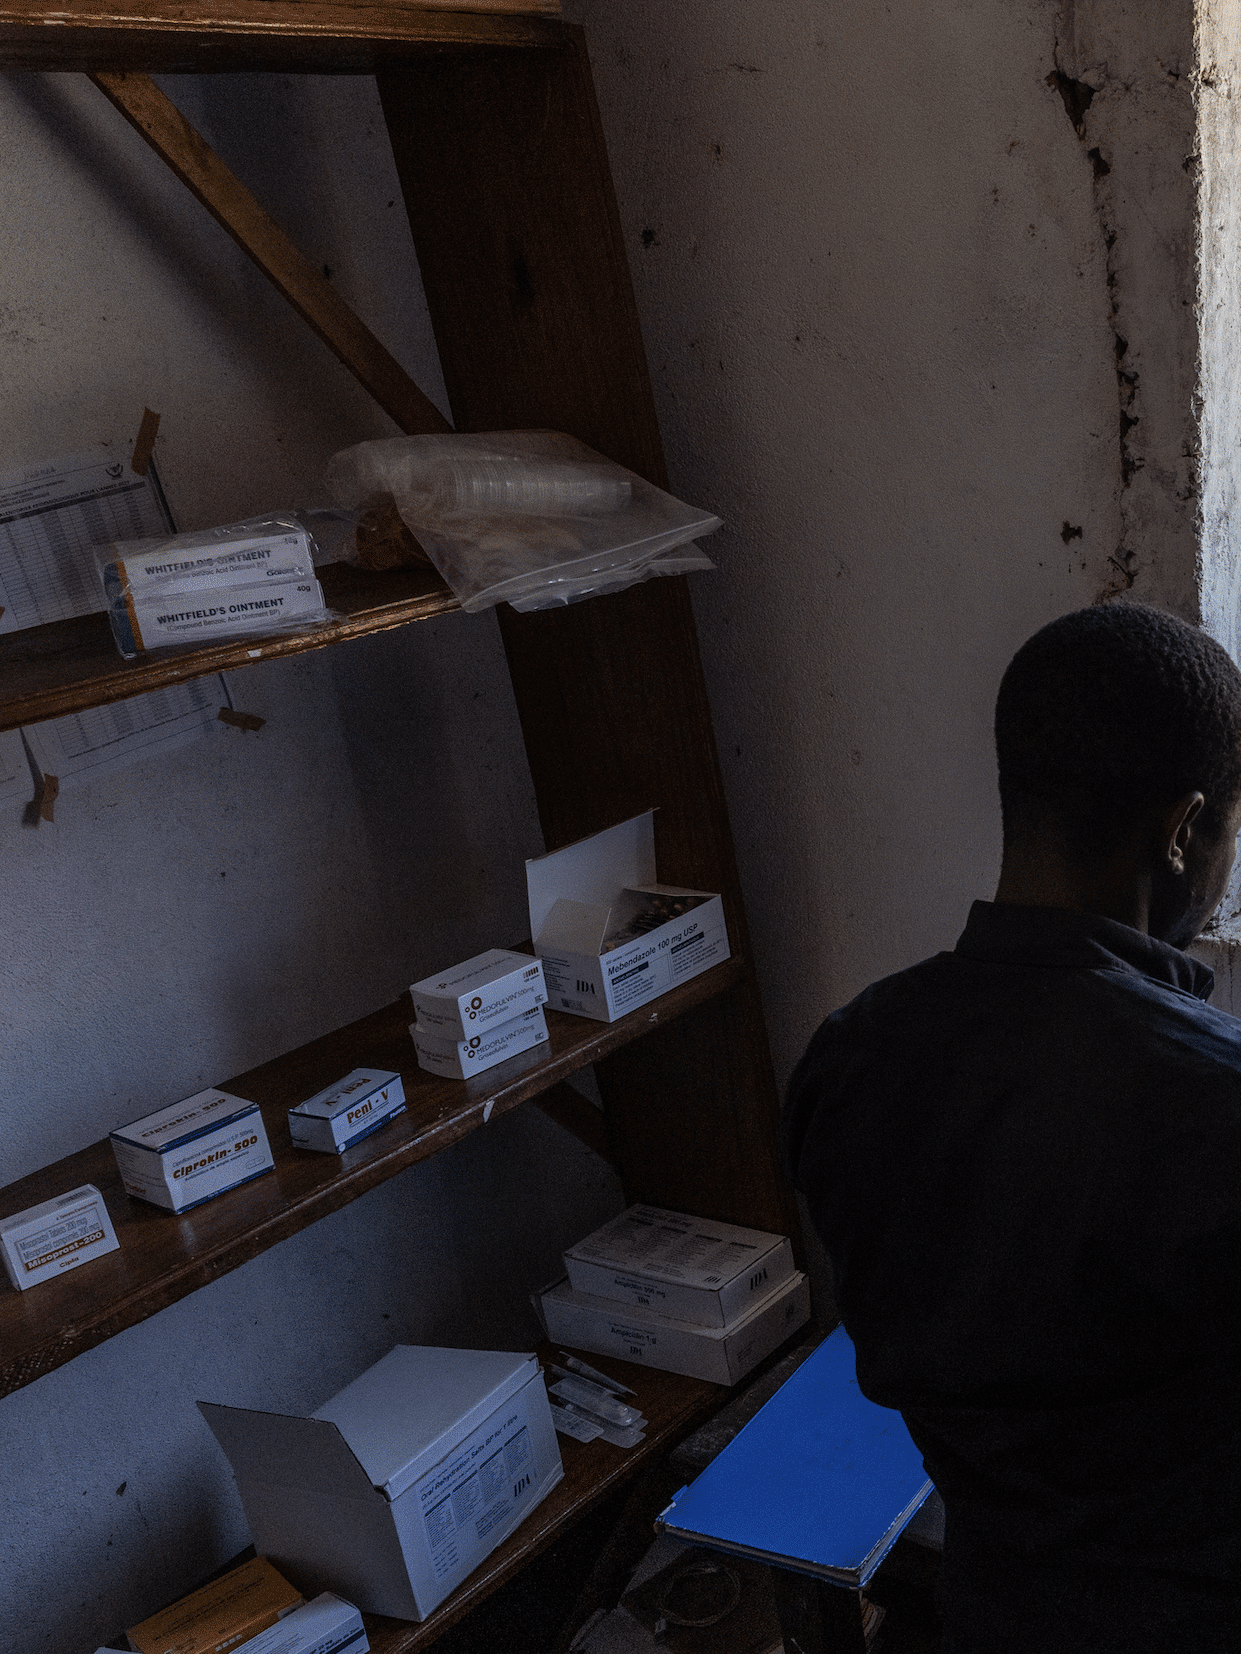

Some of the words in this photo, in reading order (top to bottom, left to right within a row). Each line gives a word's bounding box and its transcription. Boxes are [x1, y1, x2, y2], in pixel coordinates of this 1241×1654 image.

[144, 557, 213, 576] WHITFIELD'S
[216, 549, 272, 565] OINTMENT
[296, 584, 311, 593] 40g
[156, 605, 226, 625] WHITFIELD'S
[228, 596, 285, 613] OINTMENT
[166, 620, 202, 632] (Compound
[203, 617, 226, 625] Benzoic
[241, 610, 268, 620] Ointment
[268, 608, 280, 616] BP)
[607, 944, 656, 976] Mebendazole
[657, 937, 670, 950] 100
[670, 932, 682, 945] mg
[682, 922, 698, 936] USP
[575, 979, 595, 994] IDA
[343, 1079, 371, 1095] Peni
[199, 1098, 228, 1110] 500
[346, 1098, 372, 1123] Peni
[380, 1087, 389, 1101] V
[172, 1145, 232, 1180] Ciprokin-
[233, 1134, 258, 1152] 500
[19, 1231, 49, 1251] Misoprostol
[48, 1224, 66, 1238] Tablets
[65, 1220, 76, 1231] 200
[75, 1216, 88, 1227] mcg
[22, 1241, 53, 1261] Misoprostol
[78, 1225, 89, 1236] 200
[88, 1221, 100, 1233] mcg
[27, 1230, 103, 1269] Misoprost-200
[59, 1255, 79, 1268] Cipla
[610, 1326, 644, 1341] Ampicillin
[420, 1486, 434, 1502] Oral
[434, 1454, 470, 1492] Rehydration
[470, 1442, 484, 1459] Salts
[484, 1433, 494, 1446] BP
[507, 1413, 517, 1427] litre
[512, 1472, 530, 1498] IDA
